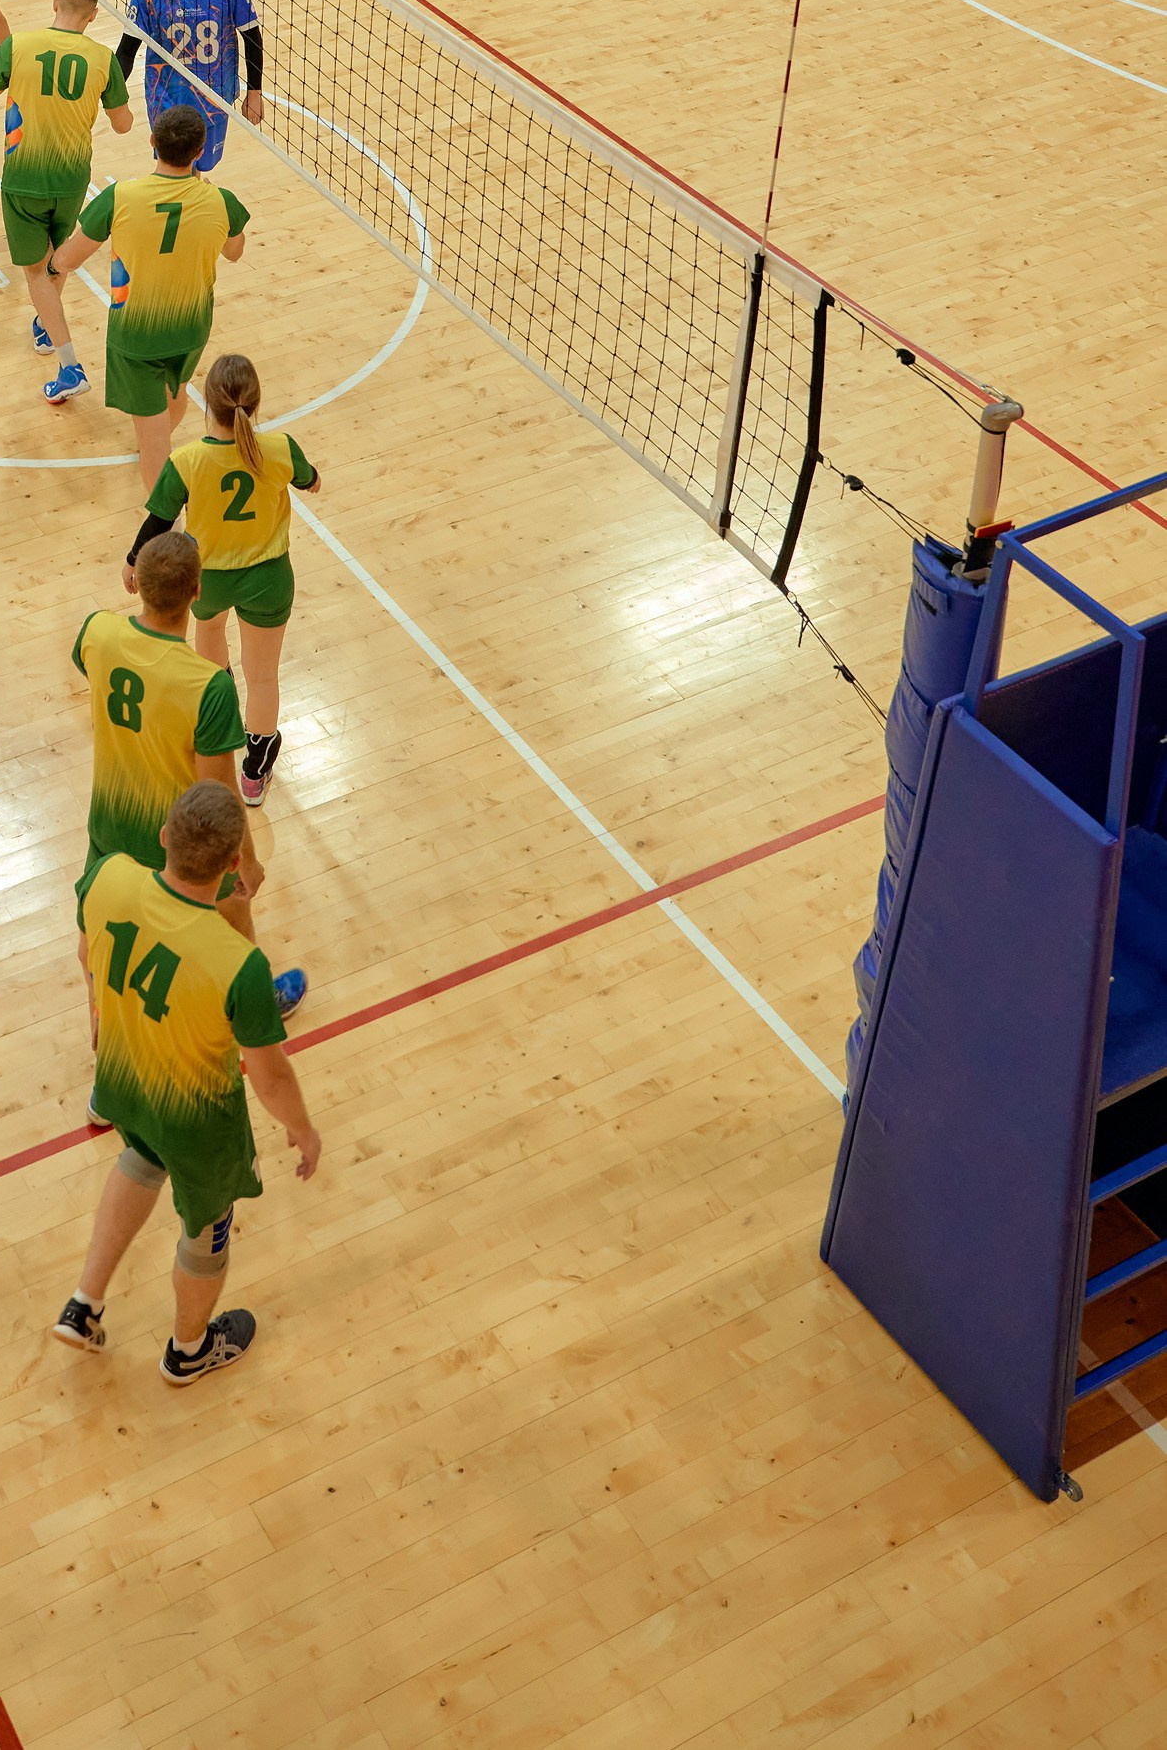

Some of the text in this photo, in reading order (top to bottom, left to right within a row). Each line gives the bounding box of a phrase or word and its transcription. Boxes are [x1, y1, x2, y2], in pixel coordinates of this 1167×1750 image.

[167, 20, 220, 65] 28
[35, 50, 89, 101] 10
[155, 202, 183, 255] 7
[220, 470, 256, 522] 2
[107, 666, 145, 733] 8
[105, 920, 182, 1024] 14
